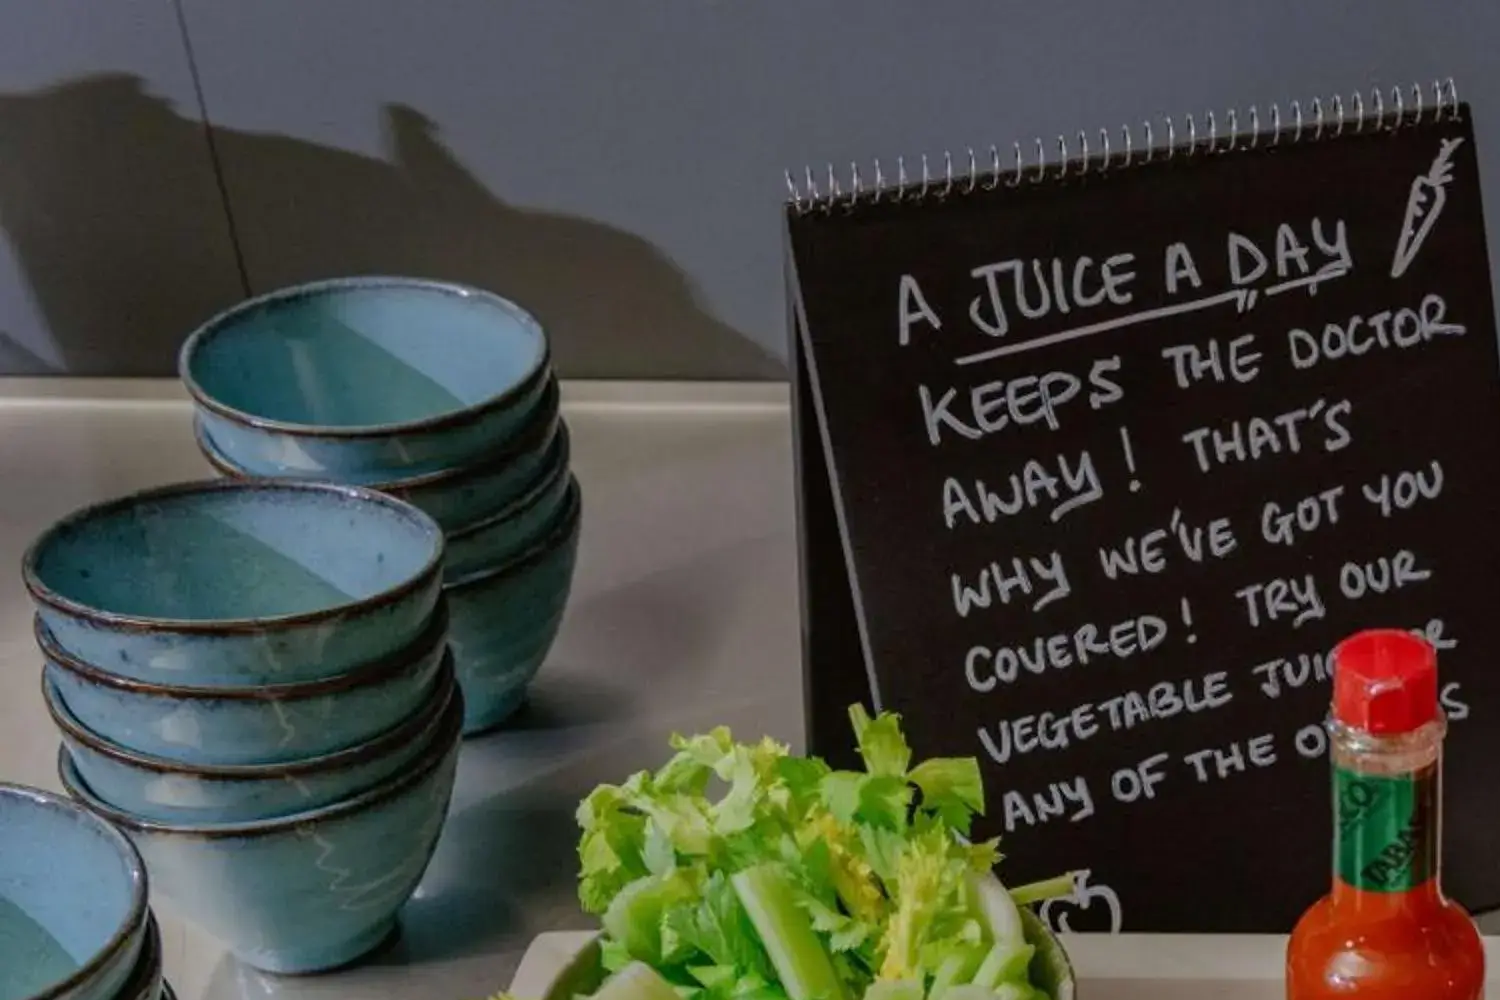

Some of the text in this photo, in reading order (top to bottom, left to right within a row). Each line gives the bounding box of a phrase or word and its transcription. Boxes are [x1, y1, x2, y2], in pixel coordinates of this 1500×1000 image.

[899, 217, 1352, 345] A JUICE A DAY
[918, 294, 1466, 446] KEEPS THE DOCTOR
[1183, 399, 1352, 473] THAT'S
[951, 460, 1444, 617] WHY WE'VE GOT YOU
[1235, 575, 1325, 628] TRY
[1339, 549, 1432, 598] OUR
[977, 671, 1233, 765] VEGETABLE
[1252, 652, 1336, 698] JUI
[1003, 733, 1277, 832] ANY OF THE
